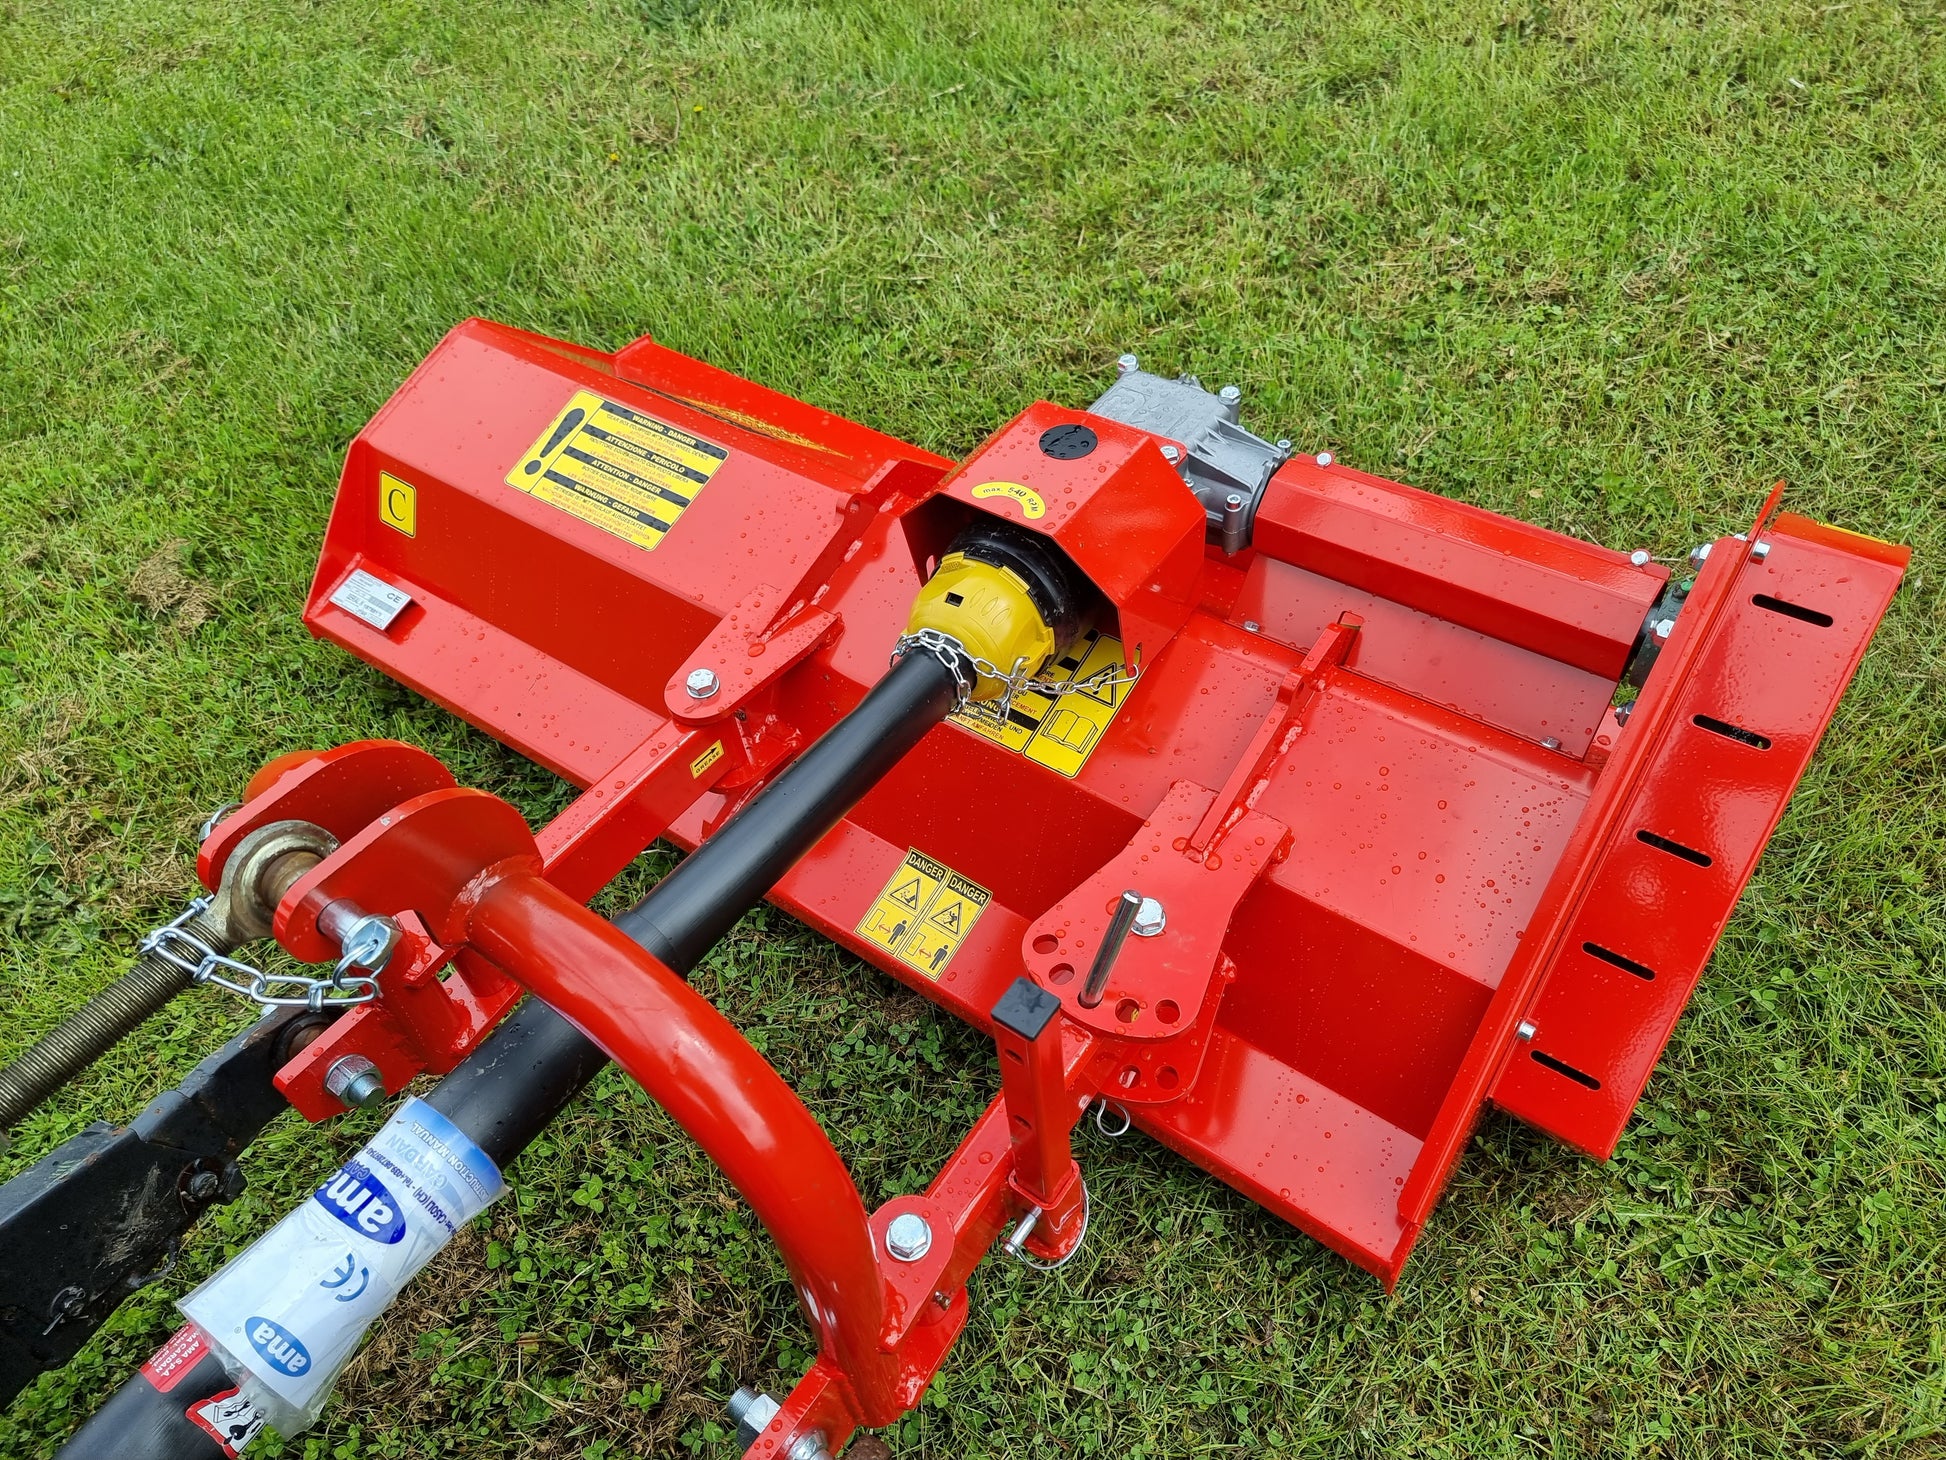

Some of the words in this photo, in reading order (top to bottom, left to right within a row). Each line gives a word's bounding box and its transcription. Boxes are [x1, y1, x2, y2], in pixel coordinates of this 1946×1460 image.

[630, 414, 665, 432] WARNING
[666, 429, 697, 446] DANGER
[604, 434, 648, 456] ATTENZIONE
[649, 453, 686, 473] PERICOLO
[590, 458, 630, 480] ATTENTION
[631, 477, 662, 494] DANGER
[388, 488, 407, 522] C
[572, 483, 609, 503] WARNUNG
[610, 500, 640, 518] GEFAHR
[1008, 486, 1026, 498] 540
[1026, 497, 1040, 512] RPM
[386, 592, 402, 604] CE
[696, 750, 720, 773] GREASE
[908, 854, 944, 880] DANGER
[950, 877, 988, 904] DANGER
[409, 1120, 450, 1158] MANUAL
[385, 1134, 448, 1190] CARDAN
[412, 1184, 431, 1205] (CH)
[424, 1199, 448, 1224] CASOLI
[155, 1344, 186, 1373] CARDAN
[183, 1340, 200, 1358] AMA
[254, 1321, 307, 1372] ama
[160, 1358, 182, 1376] S.p.A.
